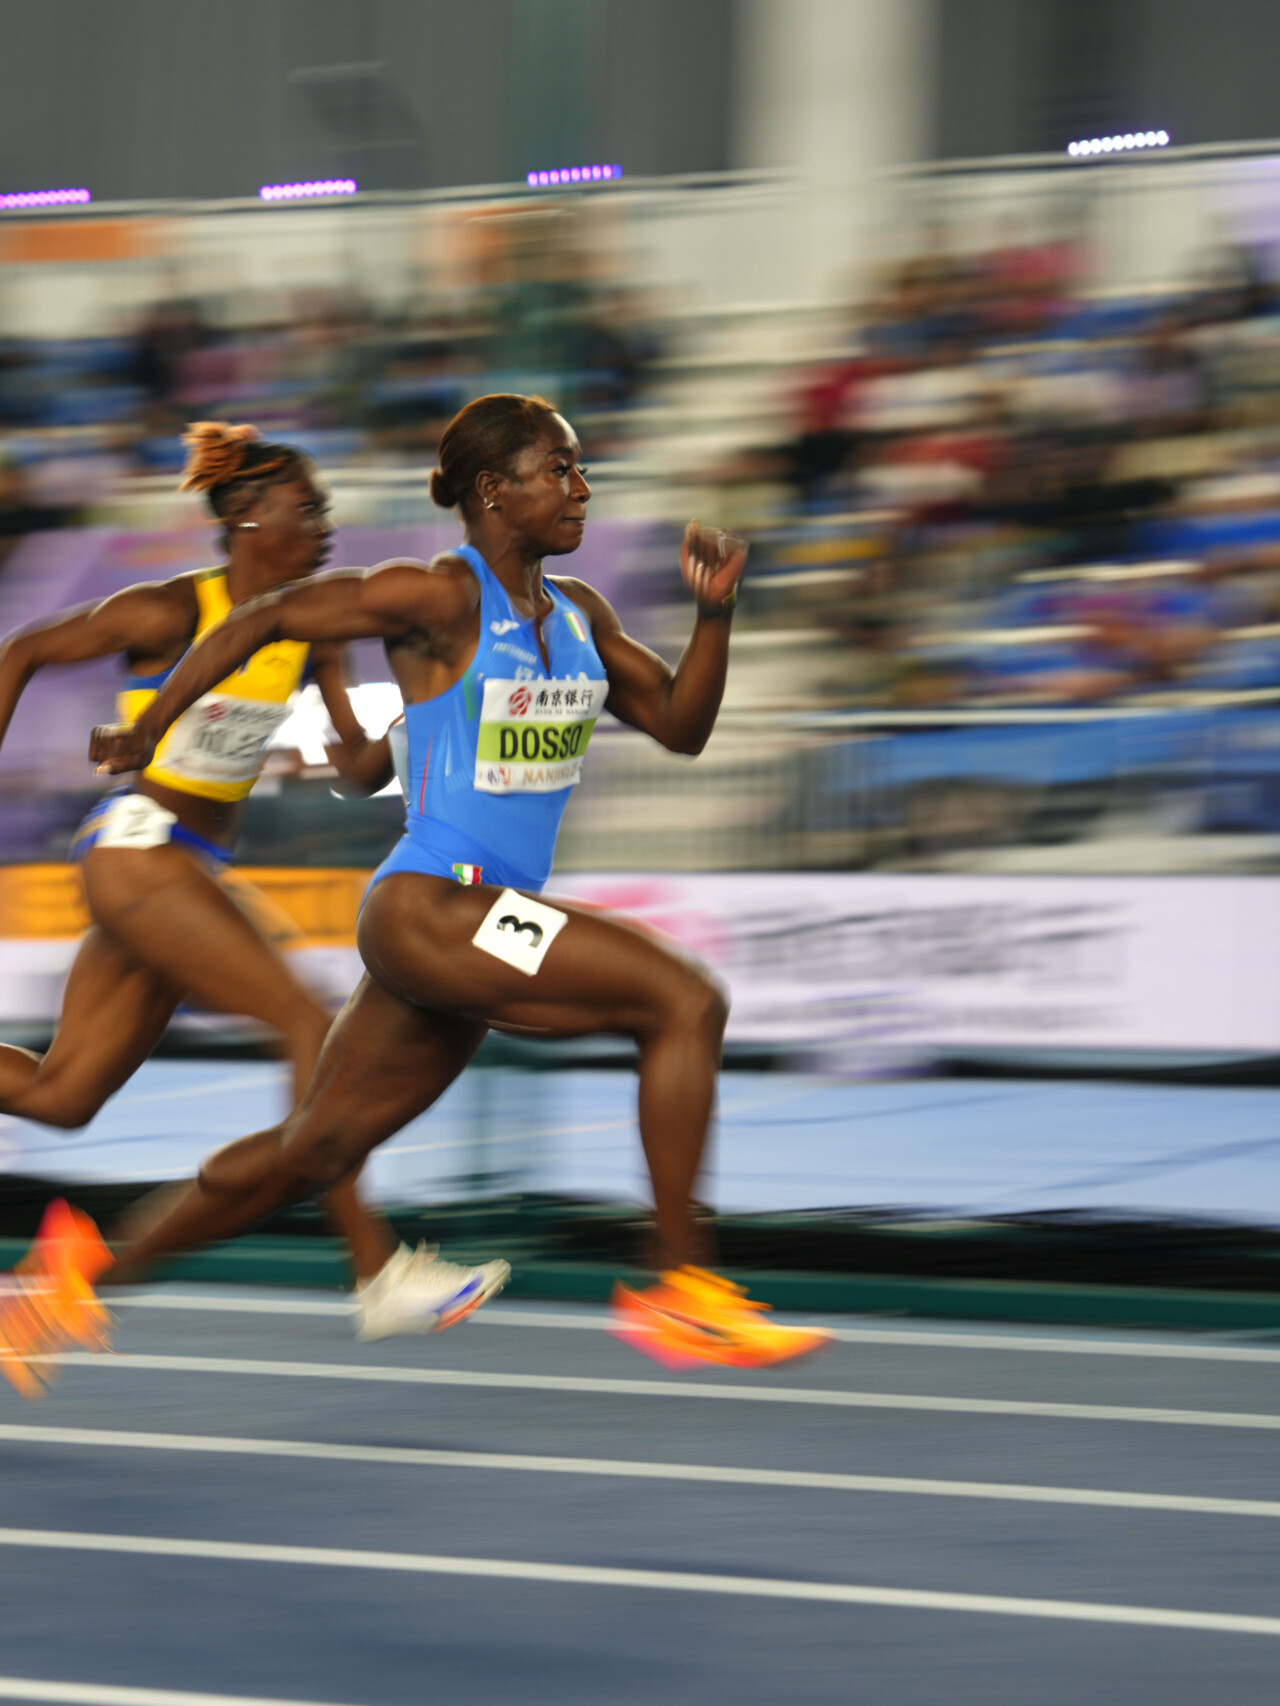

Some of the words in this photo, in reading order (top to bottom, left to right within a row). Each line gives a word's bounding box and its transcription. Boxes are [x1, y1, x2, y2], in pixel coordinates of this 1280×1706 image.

[535, 687, 593, 706] 南京银行
[499, 725, 583, 760] DOSSO
[497, 915, 543, 948] 3
